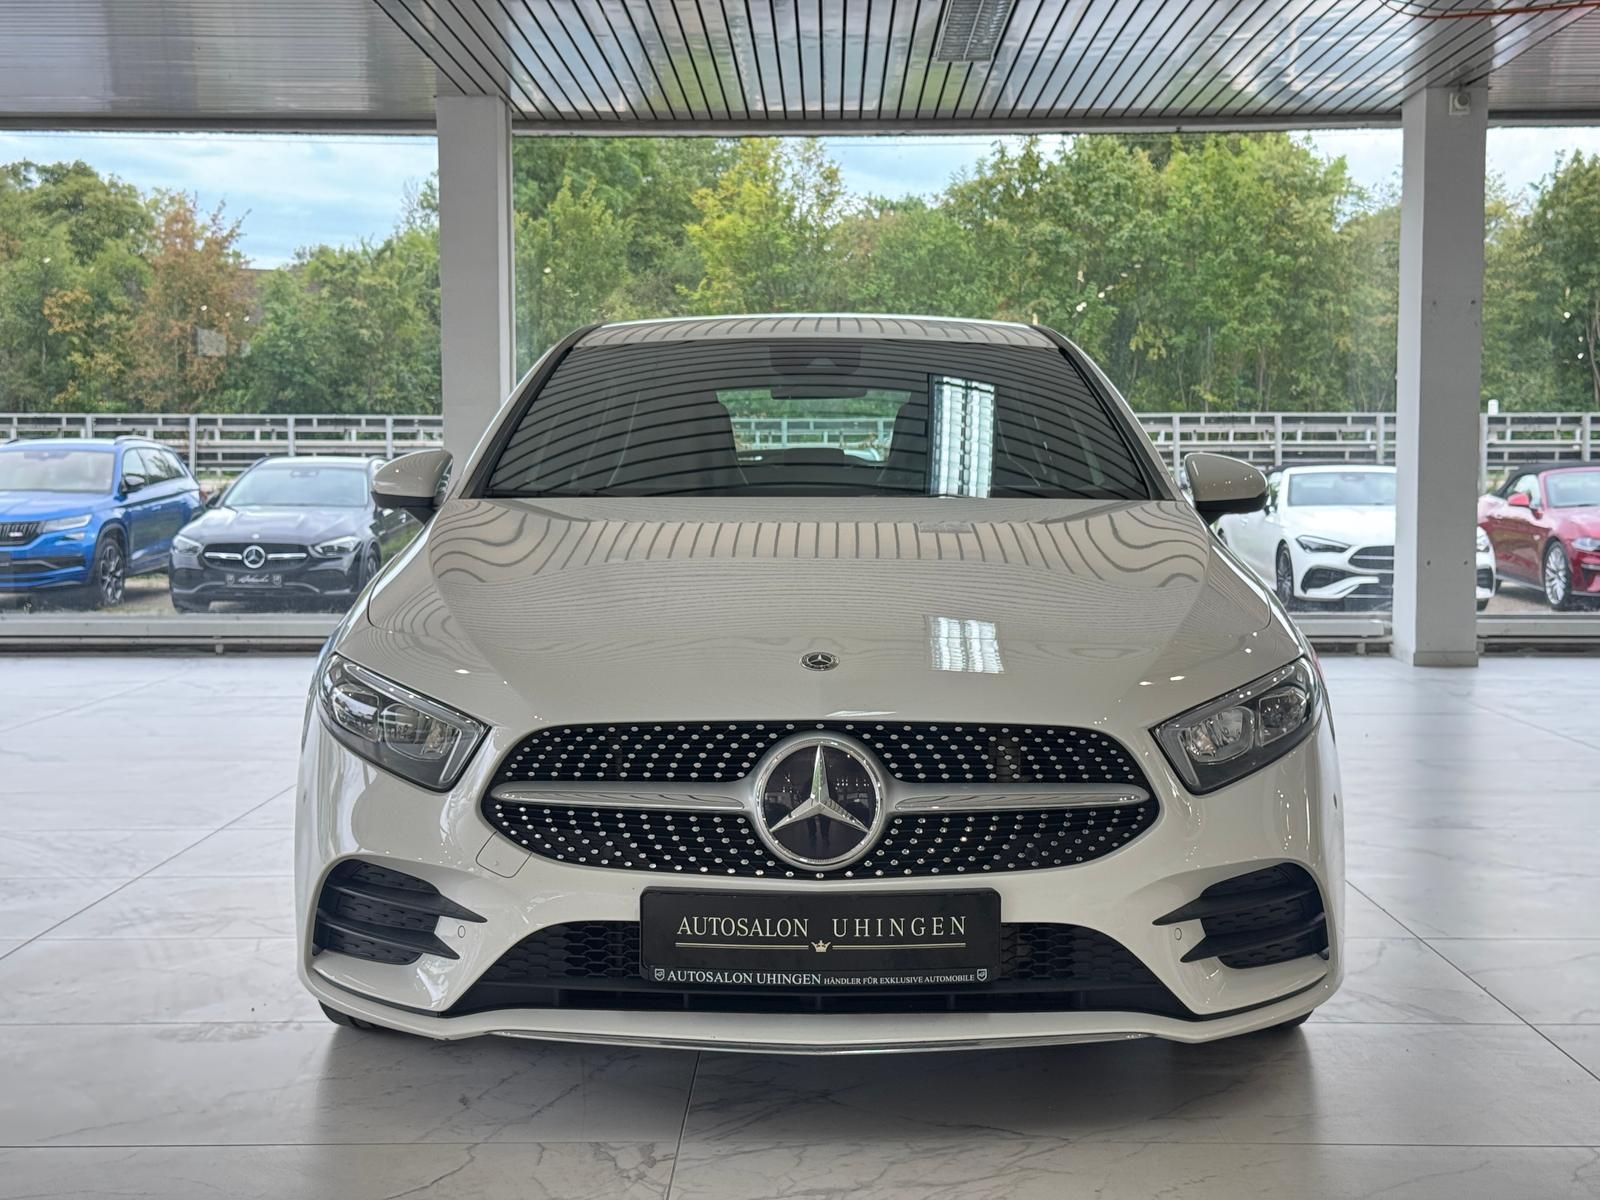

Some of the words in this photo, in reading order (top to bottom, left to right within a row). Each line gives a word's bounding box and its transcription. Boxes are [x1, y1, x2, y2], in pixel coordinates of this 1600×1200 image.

[676, 916, 809, 938] AUTOSALON
[831, 915, 966, 938] UHINGEN
[667, 970, 753, 985] AUTOSALON
[756, 972, 821, 985] UHINGEN
[823, 975, 862, 985] HÄNDLER
[862, 974, 879, 985] FÜR
[879, 975, 923, 985] EXKLUSIVE
[924, 974, 975, 984] AUTOMOBILE
